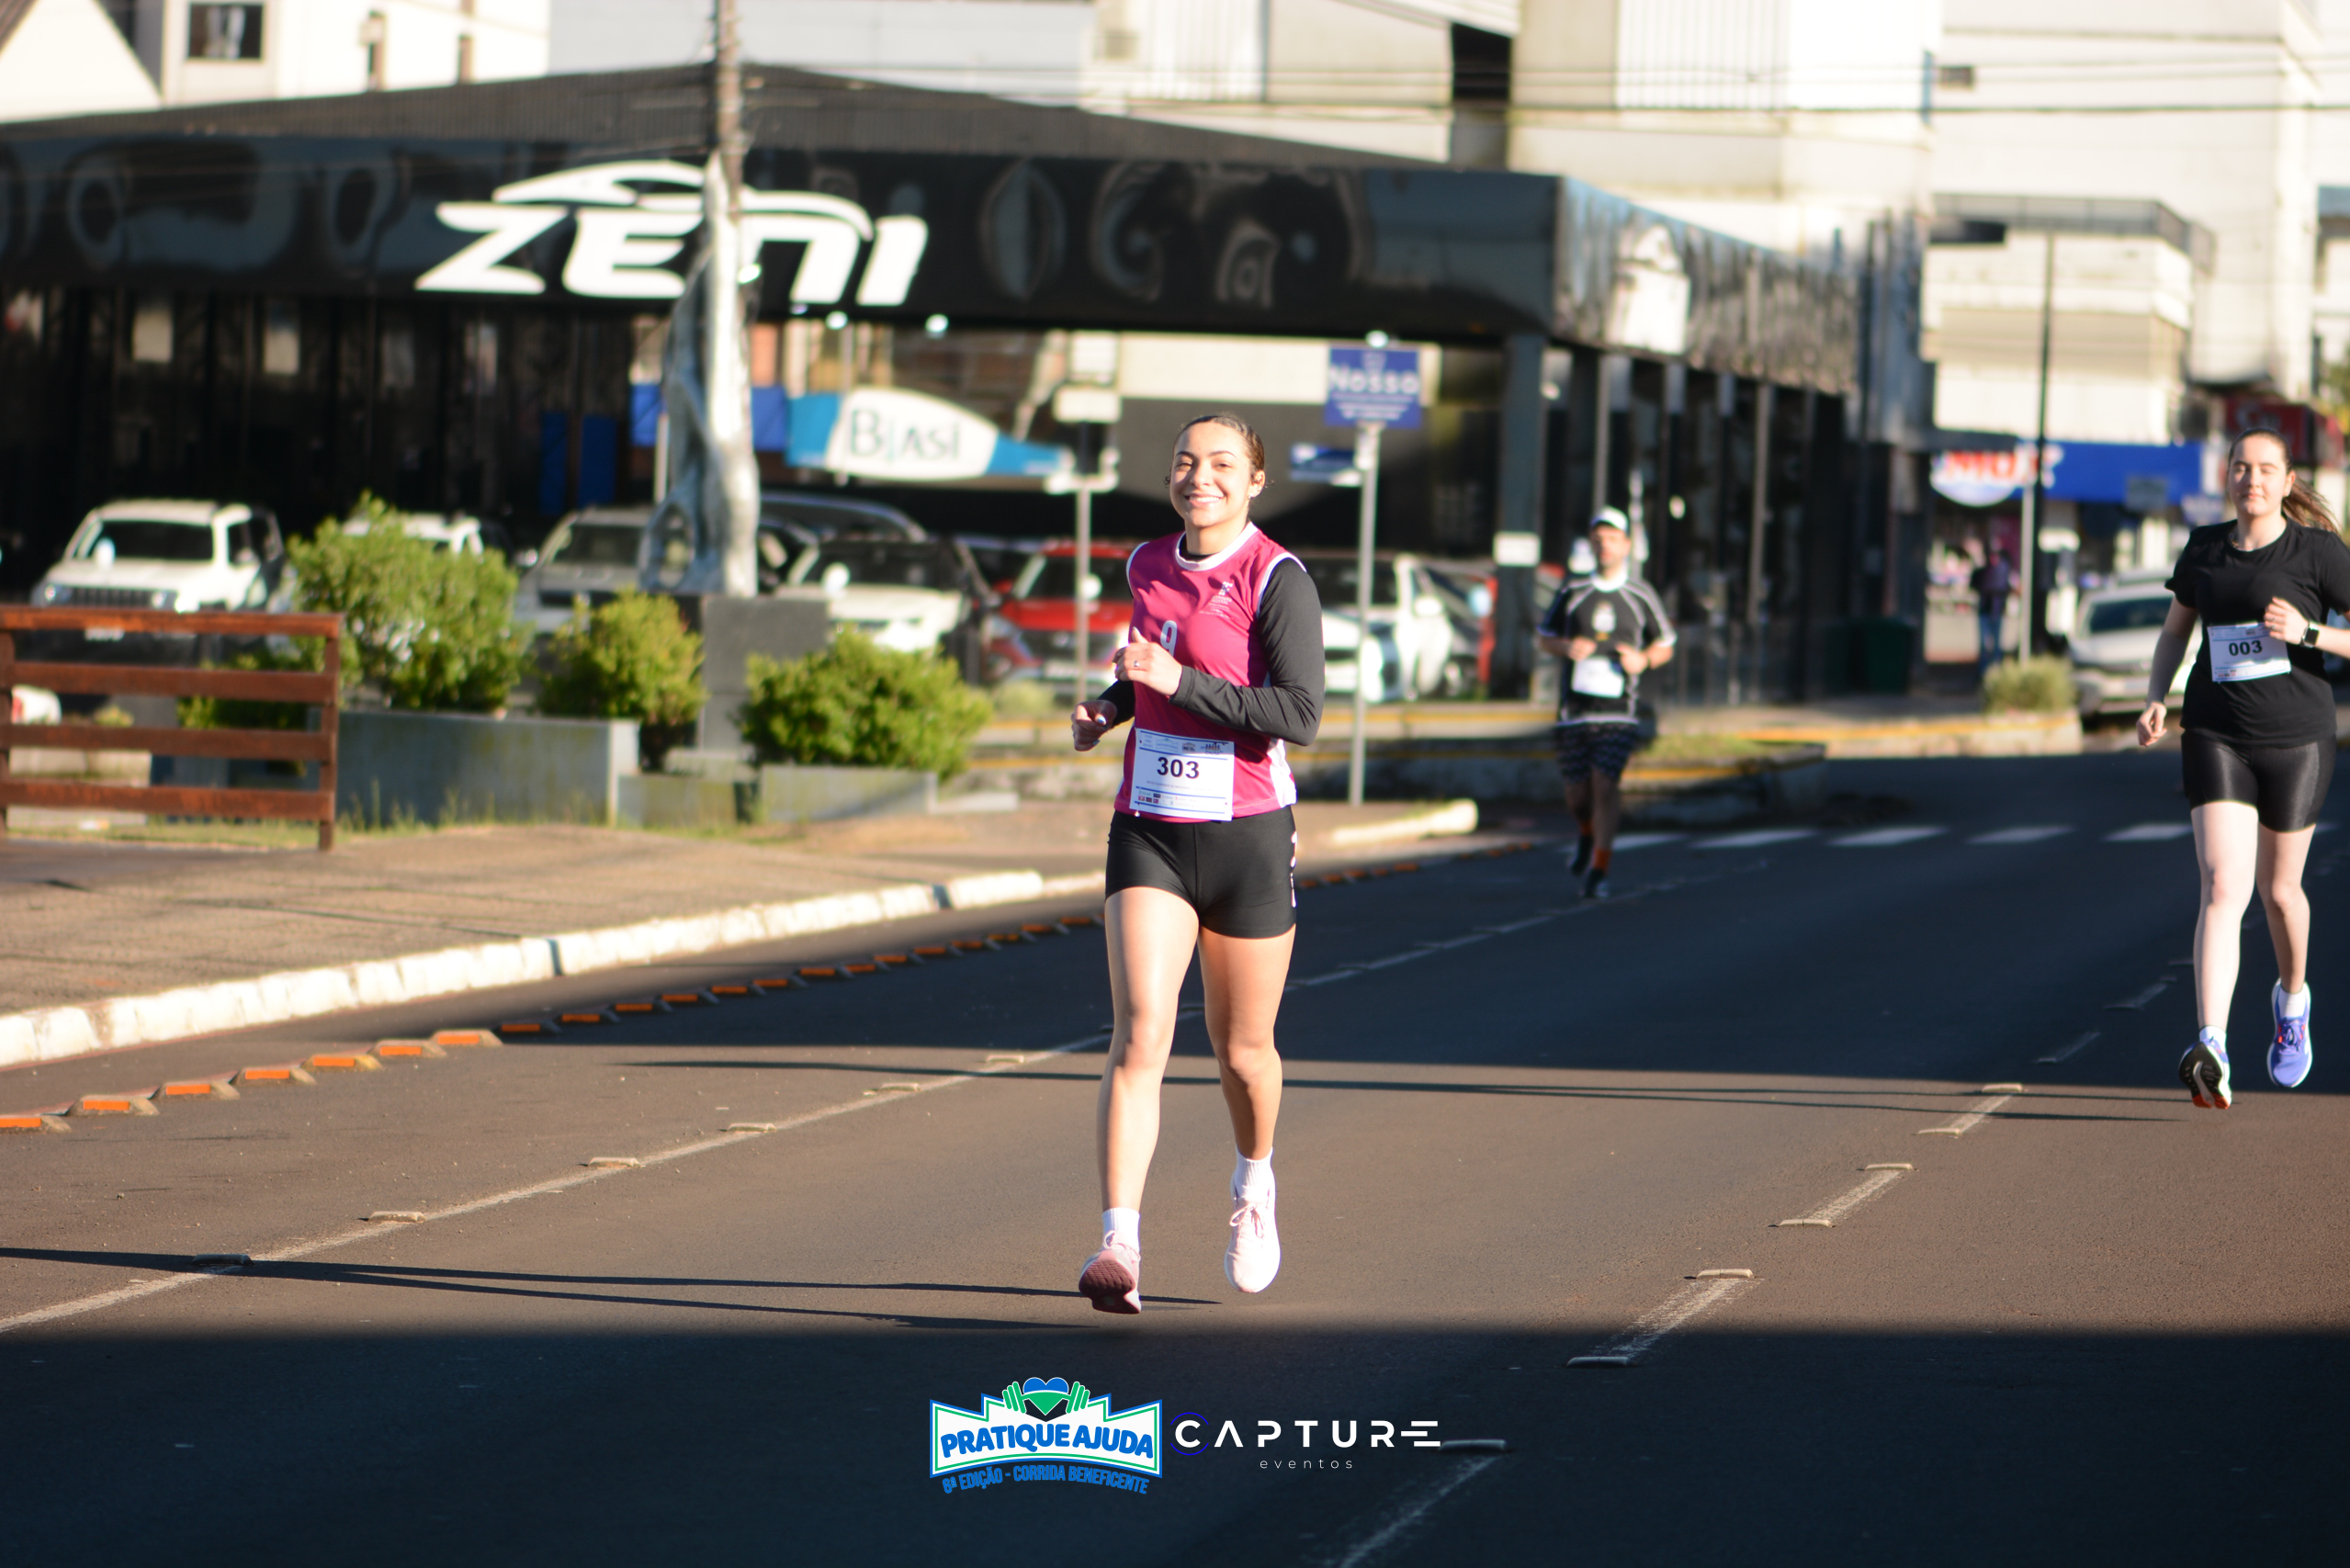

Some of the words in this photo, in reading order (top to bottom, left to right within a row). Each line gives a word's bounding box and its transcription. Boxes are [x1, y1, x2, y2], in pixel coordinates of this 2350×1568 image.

[1160, 620, 1178, 657] 9
[2229, 640, 2263, 656] 003
[1157, 757, 1199, 779] 303
